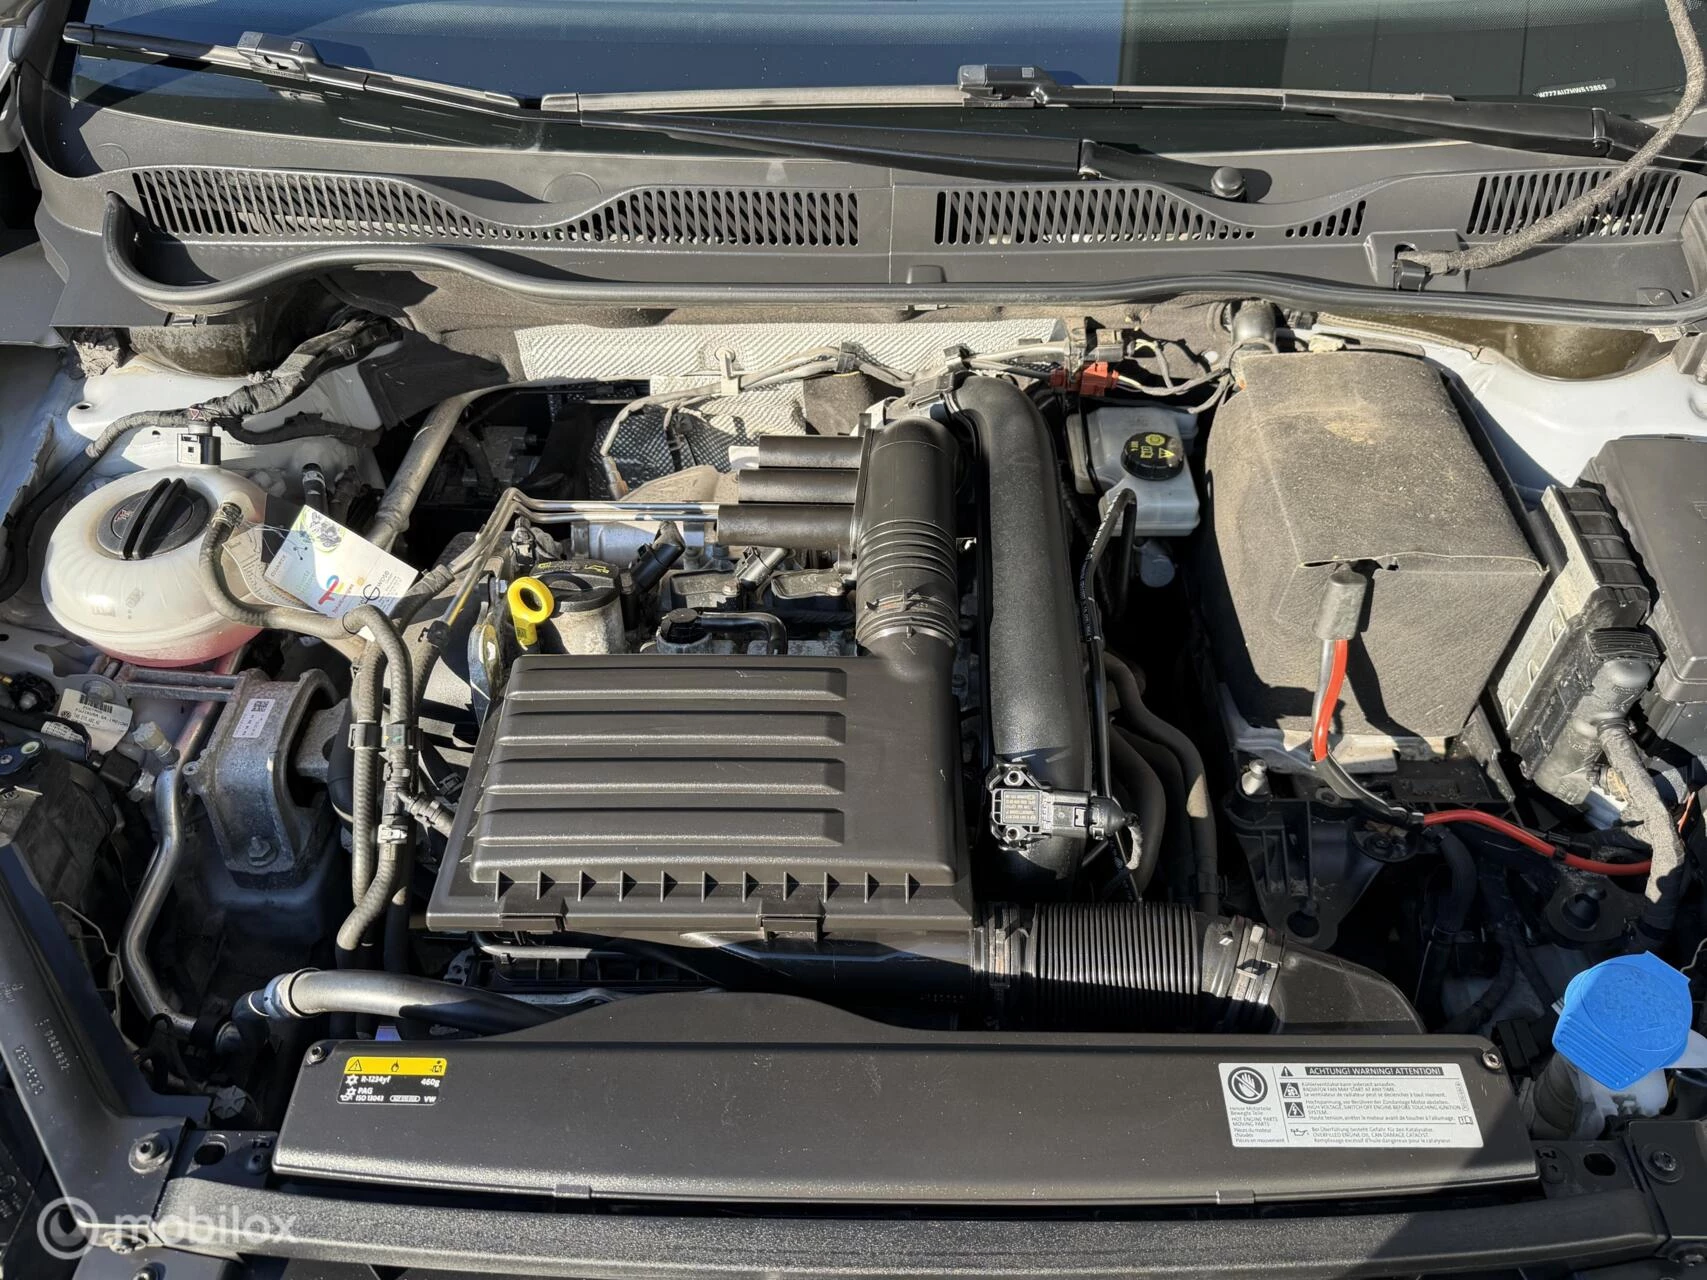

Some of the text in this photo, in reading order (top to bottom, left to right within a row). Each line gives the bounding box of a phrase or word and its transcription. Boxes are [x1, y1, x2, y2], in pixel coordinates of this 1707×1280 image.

[1309, 1067, 1440, 1076] ACHTUNG! WARNING! ATTENTION!
[360, 1075, 440, 1087] R-1234yf 460g
[357, 1087, 373, 1095] PAG
